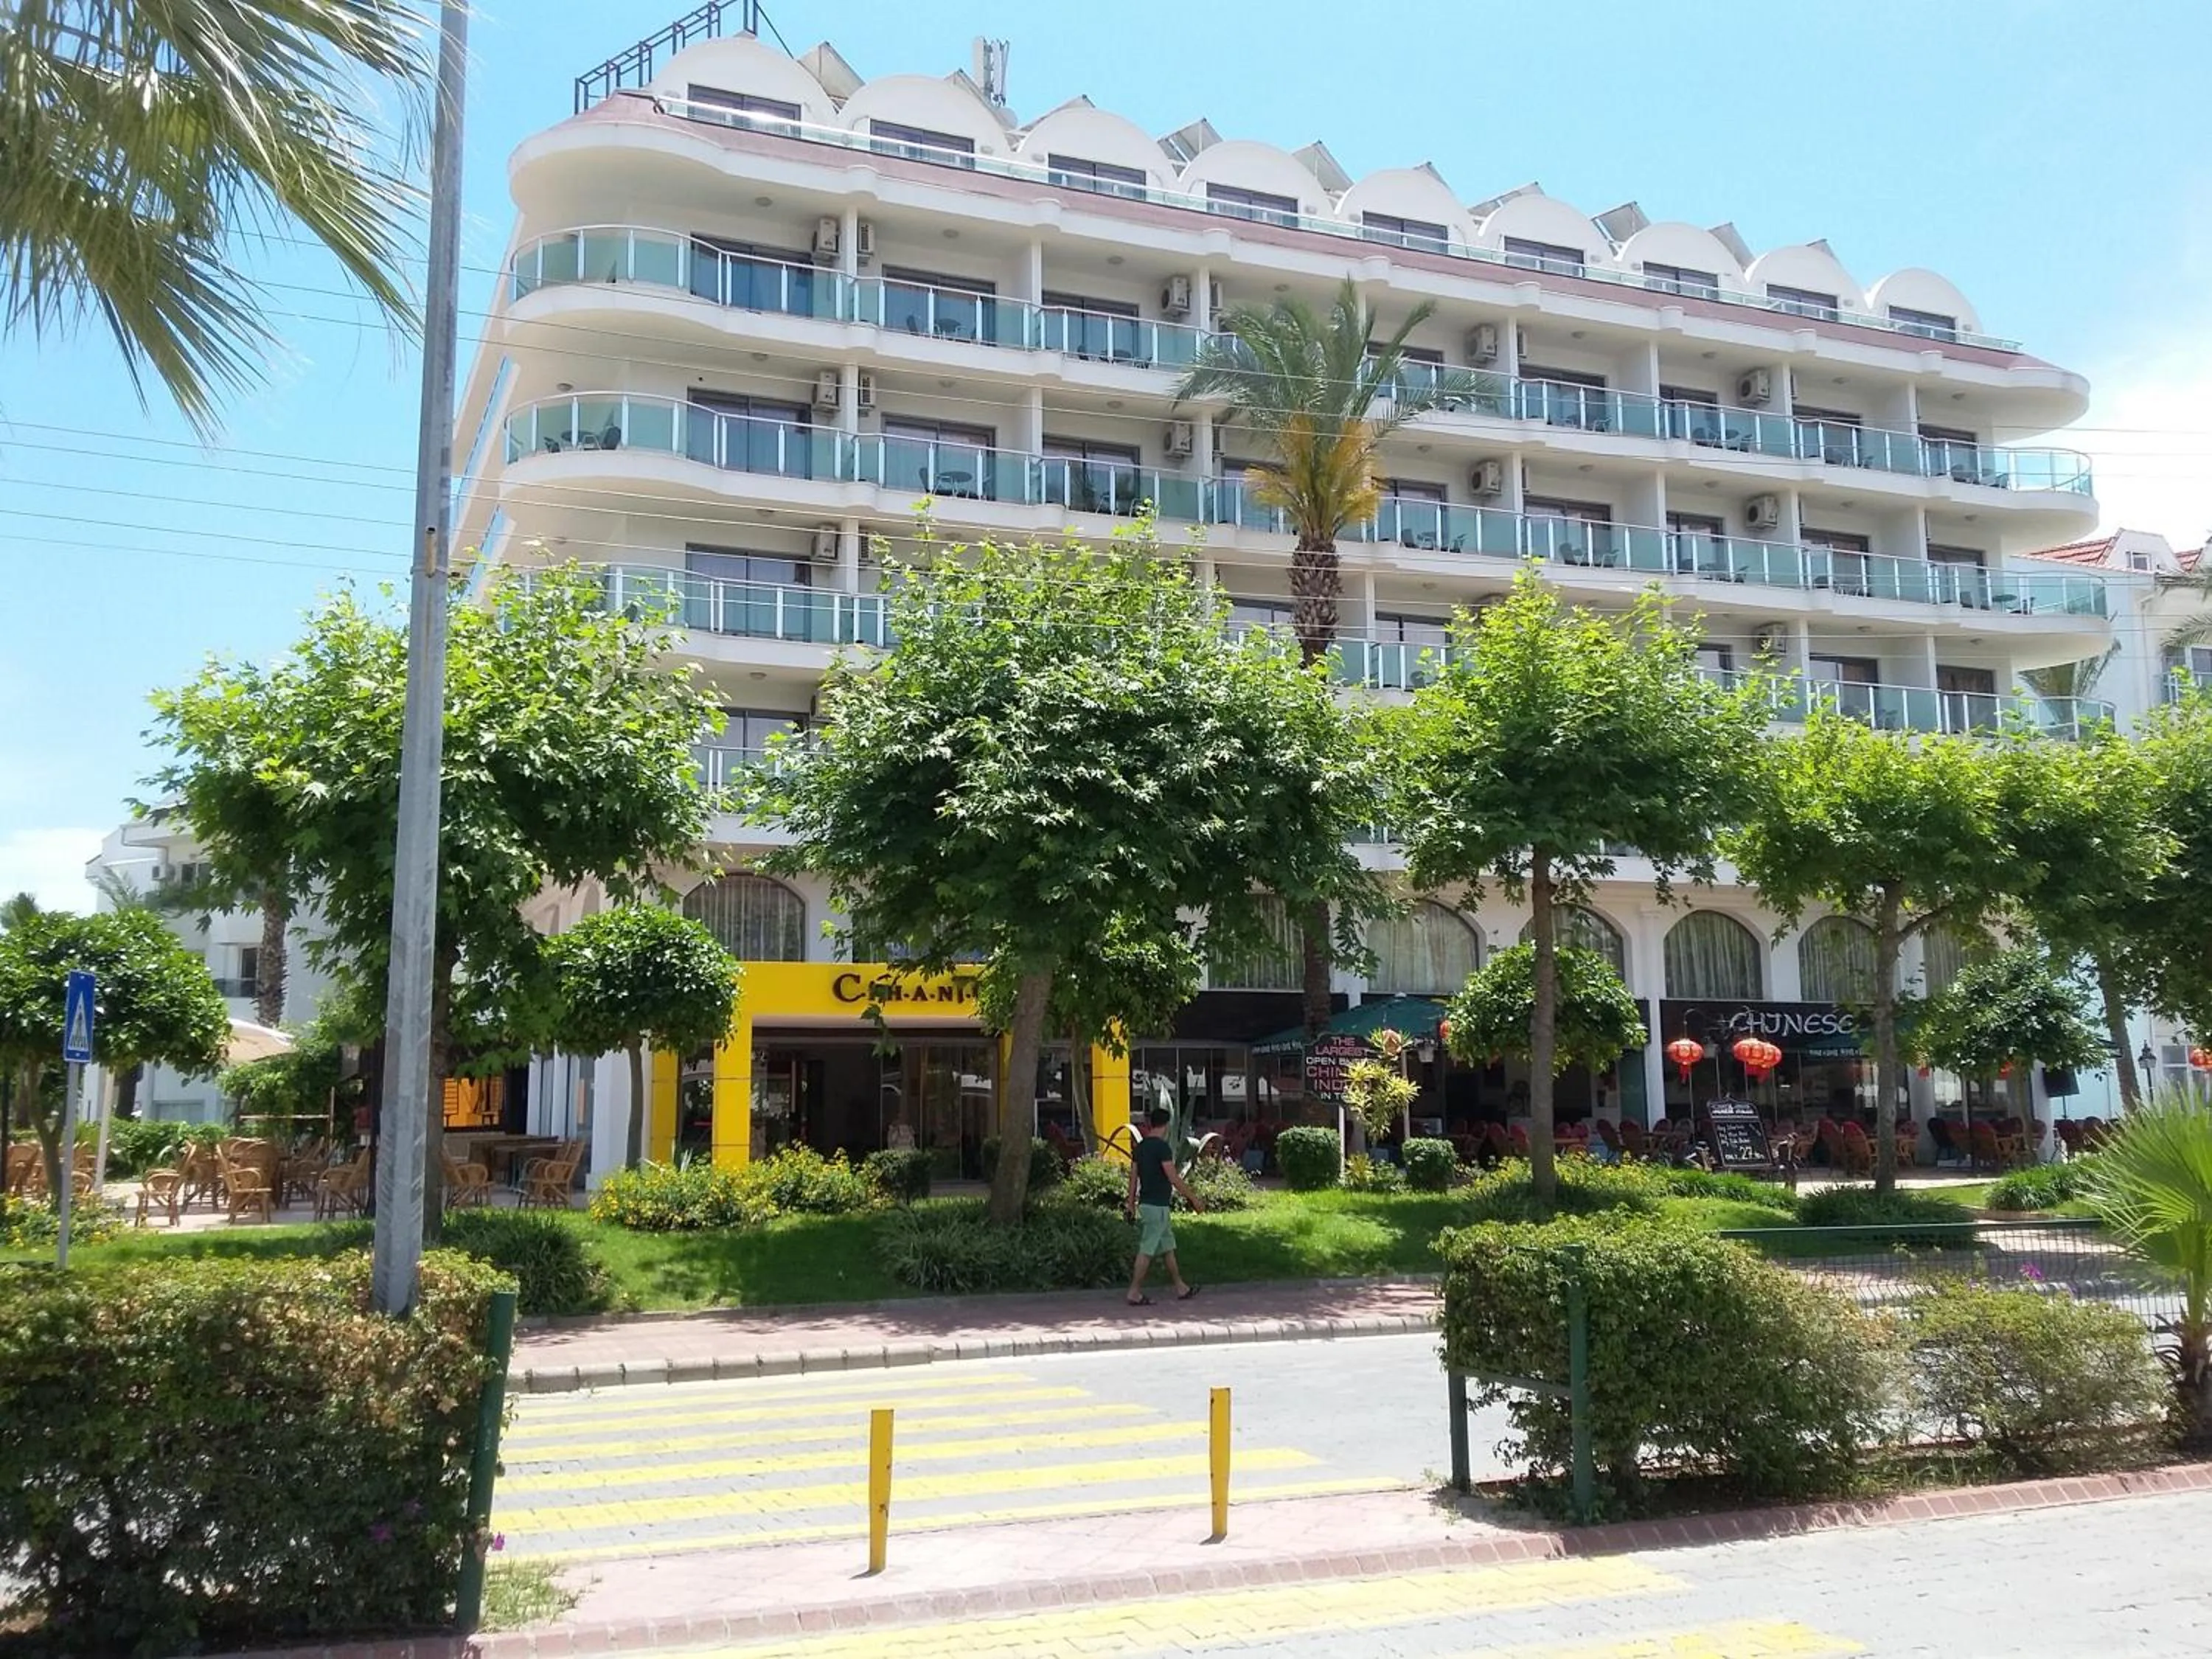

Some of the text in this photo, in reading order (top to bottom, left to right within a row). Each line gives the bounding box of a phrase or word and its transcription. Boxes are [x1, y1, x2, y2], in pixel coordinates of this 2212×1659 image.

[1331, 1036, 1356, 1046] THE
[1306, 1056, 1336, 1065] OPEN
[1306, 1065, 1349, 1077] CHIN
[1321, 1092, 1331, 1100] IN
